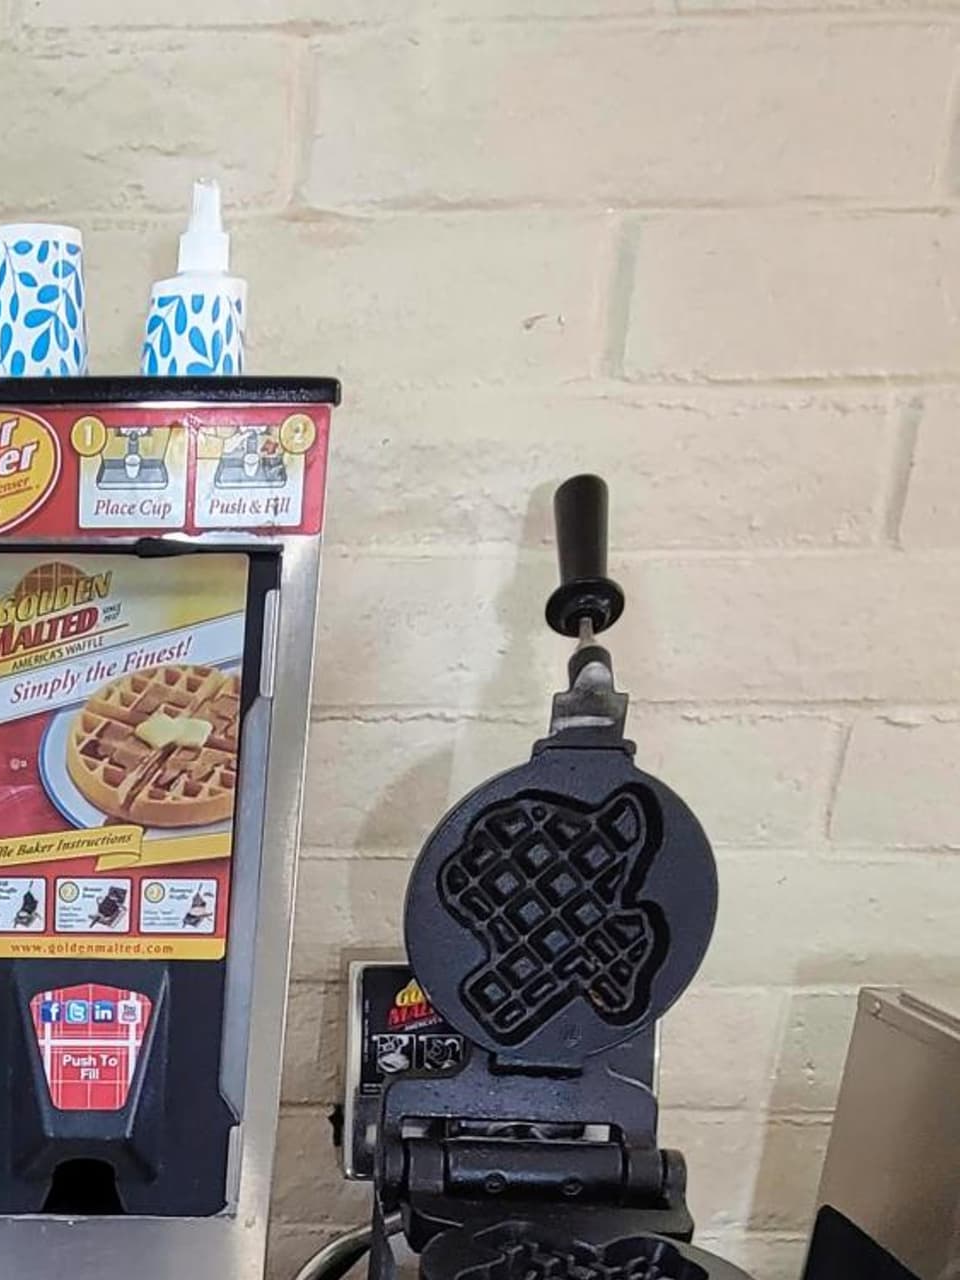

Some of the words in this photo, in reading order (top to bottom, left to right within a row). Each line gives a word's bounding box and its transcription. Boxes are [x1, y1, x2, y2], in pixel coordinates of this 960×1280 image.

[84, 424, 94, 447] 1
[94, 499, 136, 516] Place
[140, 499, 172, 519] Cup
[209, 498, 247, 515] Push
[249, 500, 261, 515] &
[265, 496, 291, 516] Fill
[11, 647, 64, 671] AMERICA'S
[65, 636, 104, 656] WAFFLE
[10, 668, 81, 704] Simply
[85, 660, 118, 683] the
[122, 635, 193, 673] Finest!
[16, 841, 54, 856] Baker
[57, 833, 133, 852] Instructions
[11, 942, 174, 955] www.goldenmalted.com
[94, 1005, 113, 1021] in
[63, 1054, 97, 1067] Push
[100, 1054, 118, 1067] To
[80, 1068, 100, 1080] Fill
